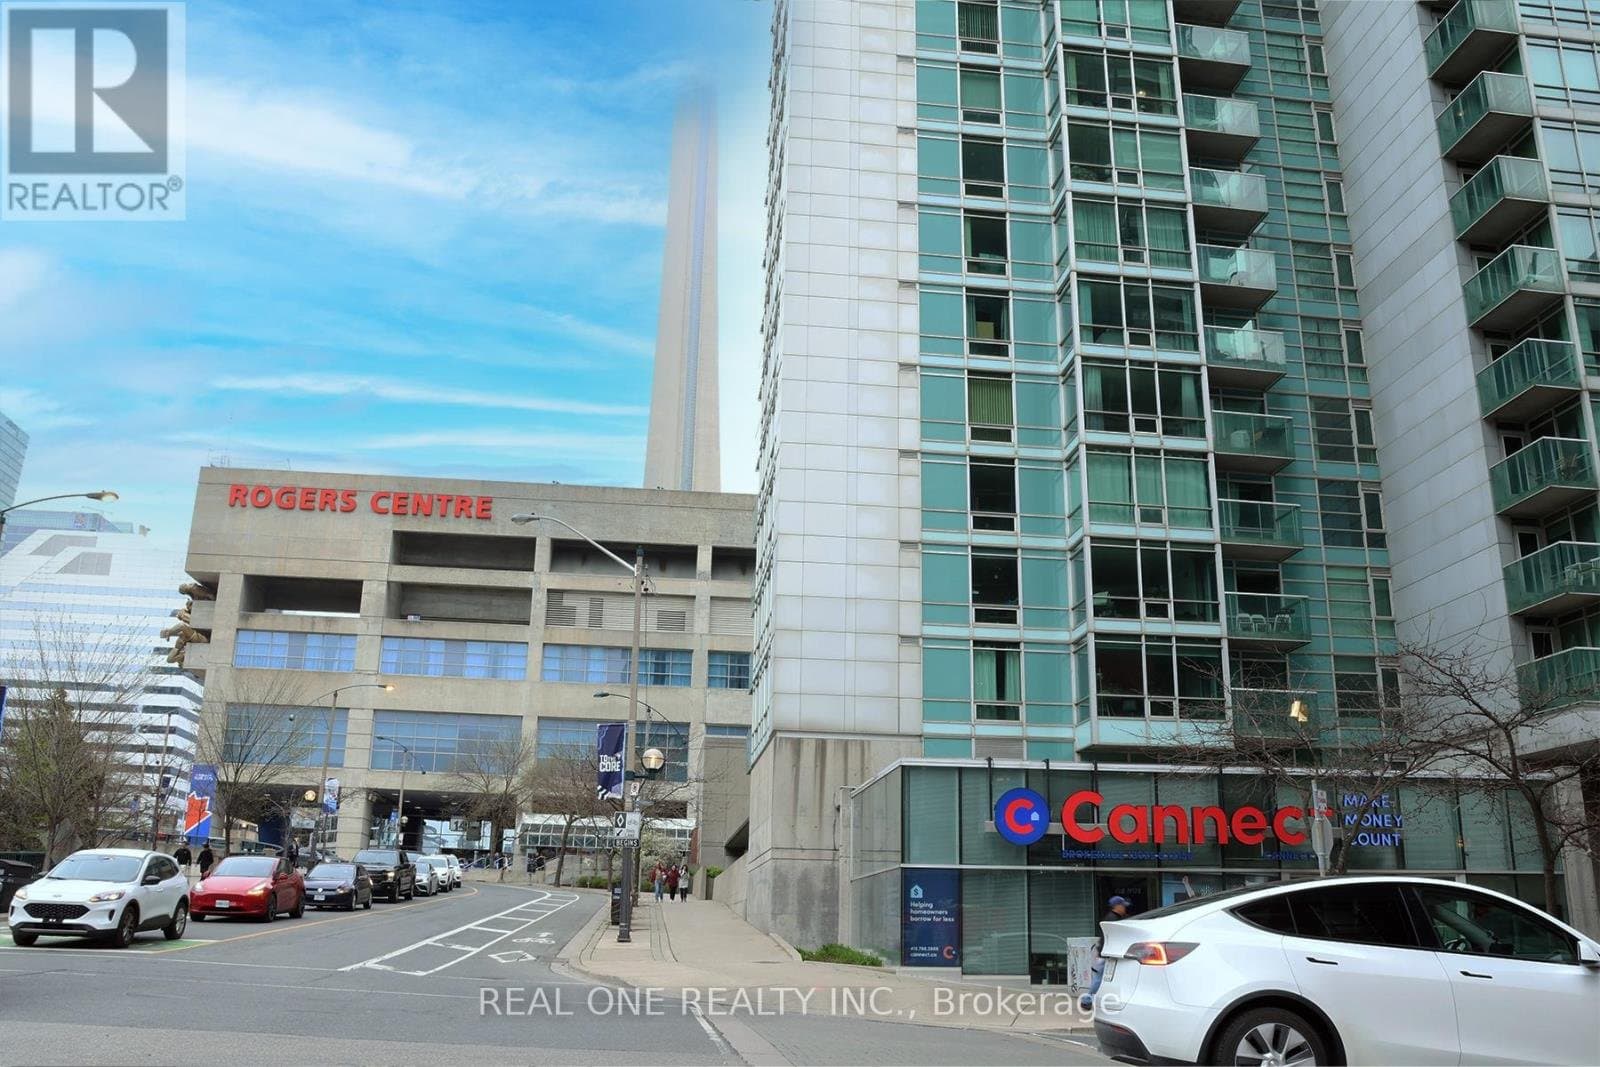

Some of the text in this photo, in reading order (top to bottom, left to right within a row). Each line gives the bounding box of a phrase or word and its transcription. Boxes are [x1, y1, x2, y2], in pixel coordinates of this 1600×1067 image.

[228, 484, 493, 519] ROGERS CENTRE
[599, 761, 621, 772] CORE
[1061, 790, 1334, 846] Cannec
[616, 839, 638, 847] BEGINS
[1348, 832, 1401, 846] OUNT
[910, 901, 934, 909] Helping
